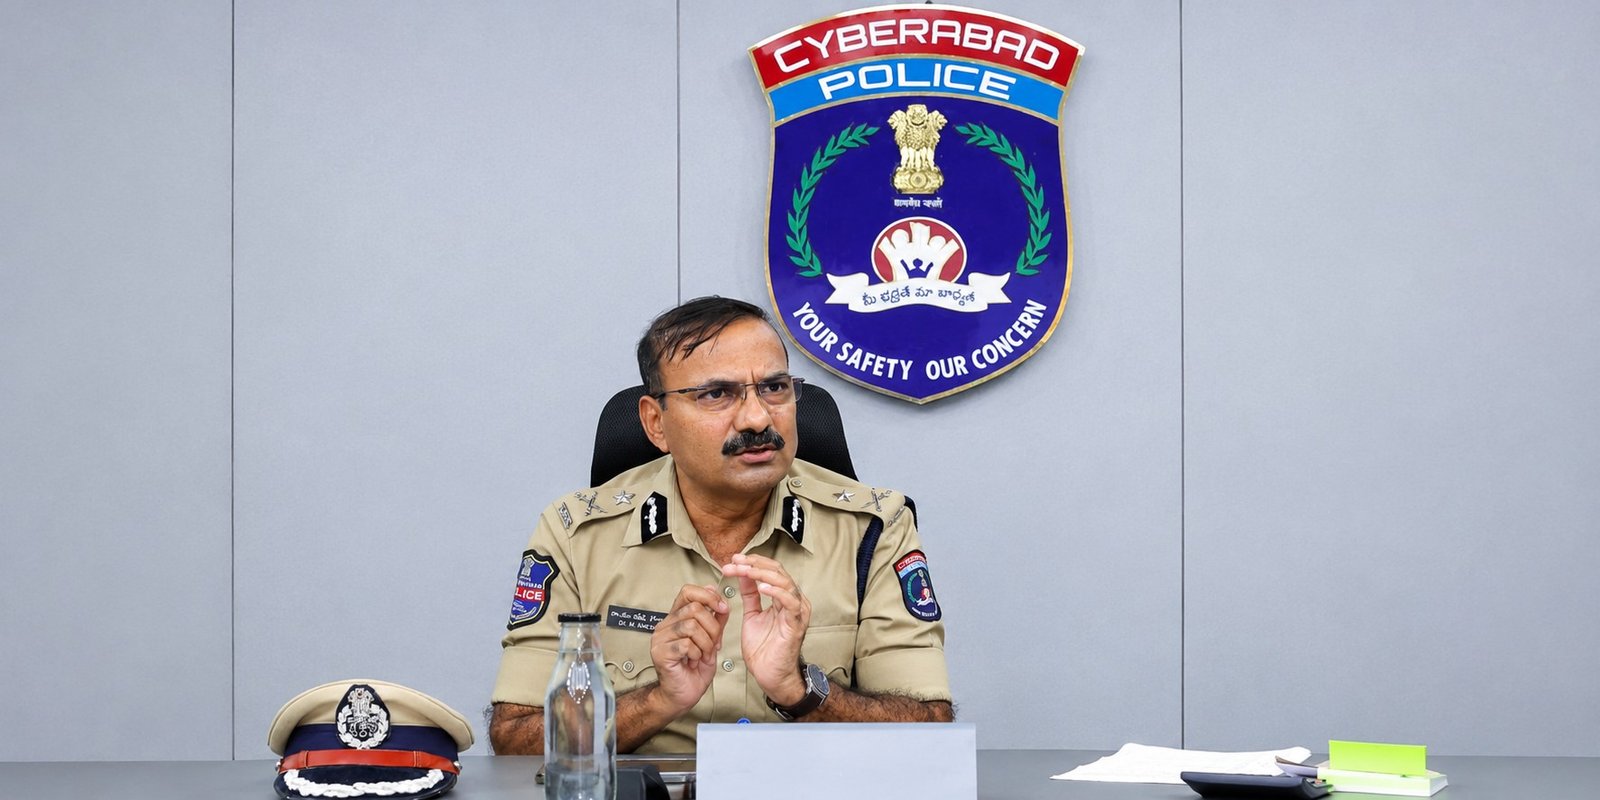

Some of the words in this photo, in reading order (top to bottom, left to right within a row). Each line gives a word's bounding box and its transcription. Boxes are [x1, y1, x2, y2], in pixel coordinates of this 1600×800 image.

[773, 18, 1060, 73] CYBERABAD
[818, 63, 1017, 100] POLICE
[792, 301, 839, 353] YOUR
[835, 342, 914, 381] SAFETY
[925, 356, 970, 381] OUR
[971, 299, 1048, 370] CONCERN
[515, 587, 543, 601] LICE
